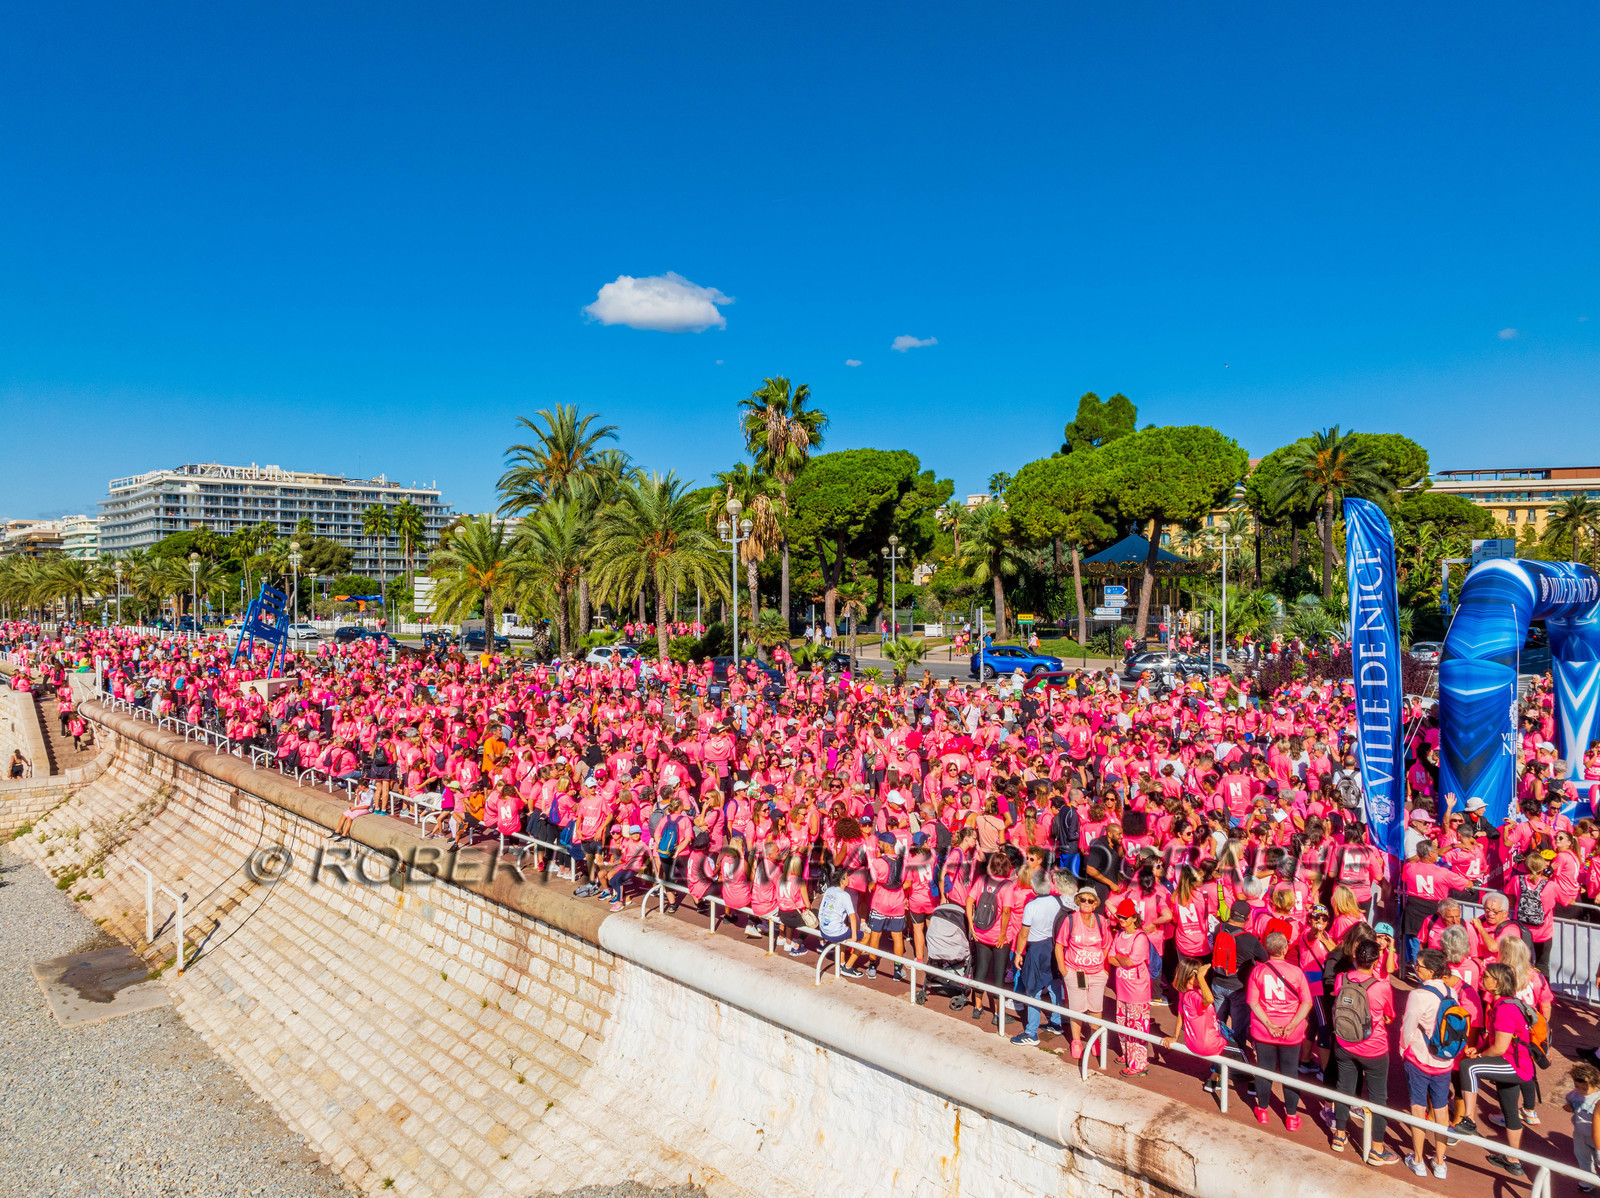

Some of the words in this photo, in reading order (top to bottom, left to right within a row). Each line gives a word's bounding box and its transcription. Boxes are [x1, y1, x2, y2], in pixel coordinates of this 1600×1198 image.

[1355, 548, 1386, 633] NICE
[1359, 642, 1389, 689] DE
[1361, 698, 1395, 787] VILLE
[617, 759, 627, 770] N
[664, 764, 677, 775] N
[461, 768, 472, 780] N
[1415, 771, 1427, 784] N
[1229, 782, 1242, 797] N
[501, 805, 512, 819] N
[1344, 849, 1362, 872] N
[1466, 858, 1481, 875] N
[918, 863, 933, 883] N
[1416, 874, 1434, 894] N
[1179, 903, 1199, 923] N
[1116, 967, 1136, 980] OSE
[1264, 974, 1285, 1001] N
